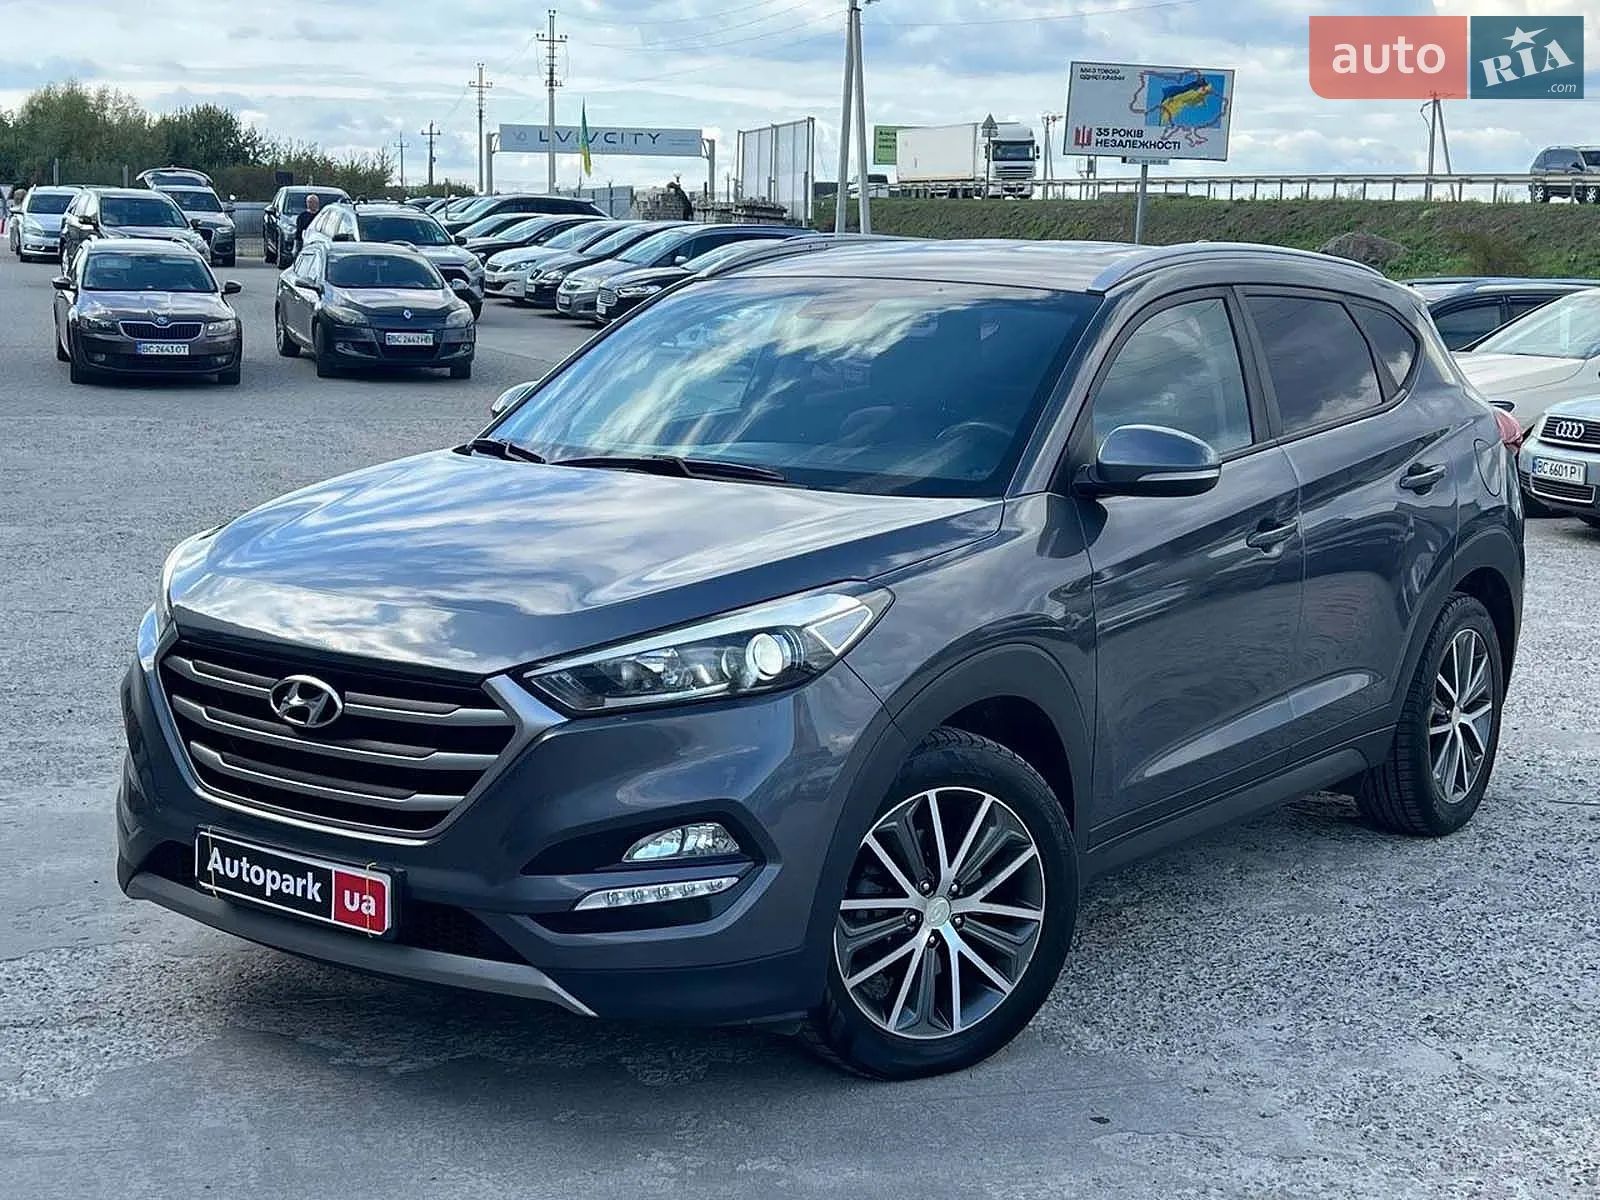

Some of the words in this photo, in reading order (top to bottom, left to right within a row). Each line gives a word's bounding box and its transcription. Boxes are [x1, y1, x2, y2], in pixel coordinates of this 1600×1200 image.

[1095, 127, 1110, 137] 35
[1111, 128, 1144, 138] РОКІВ
[1095, 138, 1181, 150] НЕЗАЛЕЖНОСТІ
[206, 846, 323, 904] Autopark
[343, 888, 376, 917] ua
